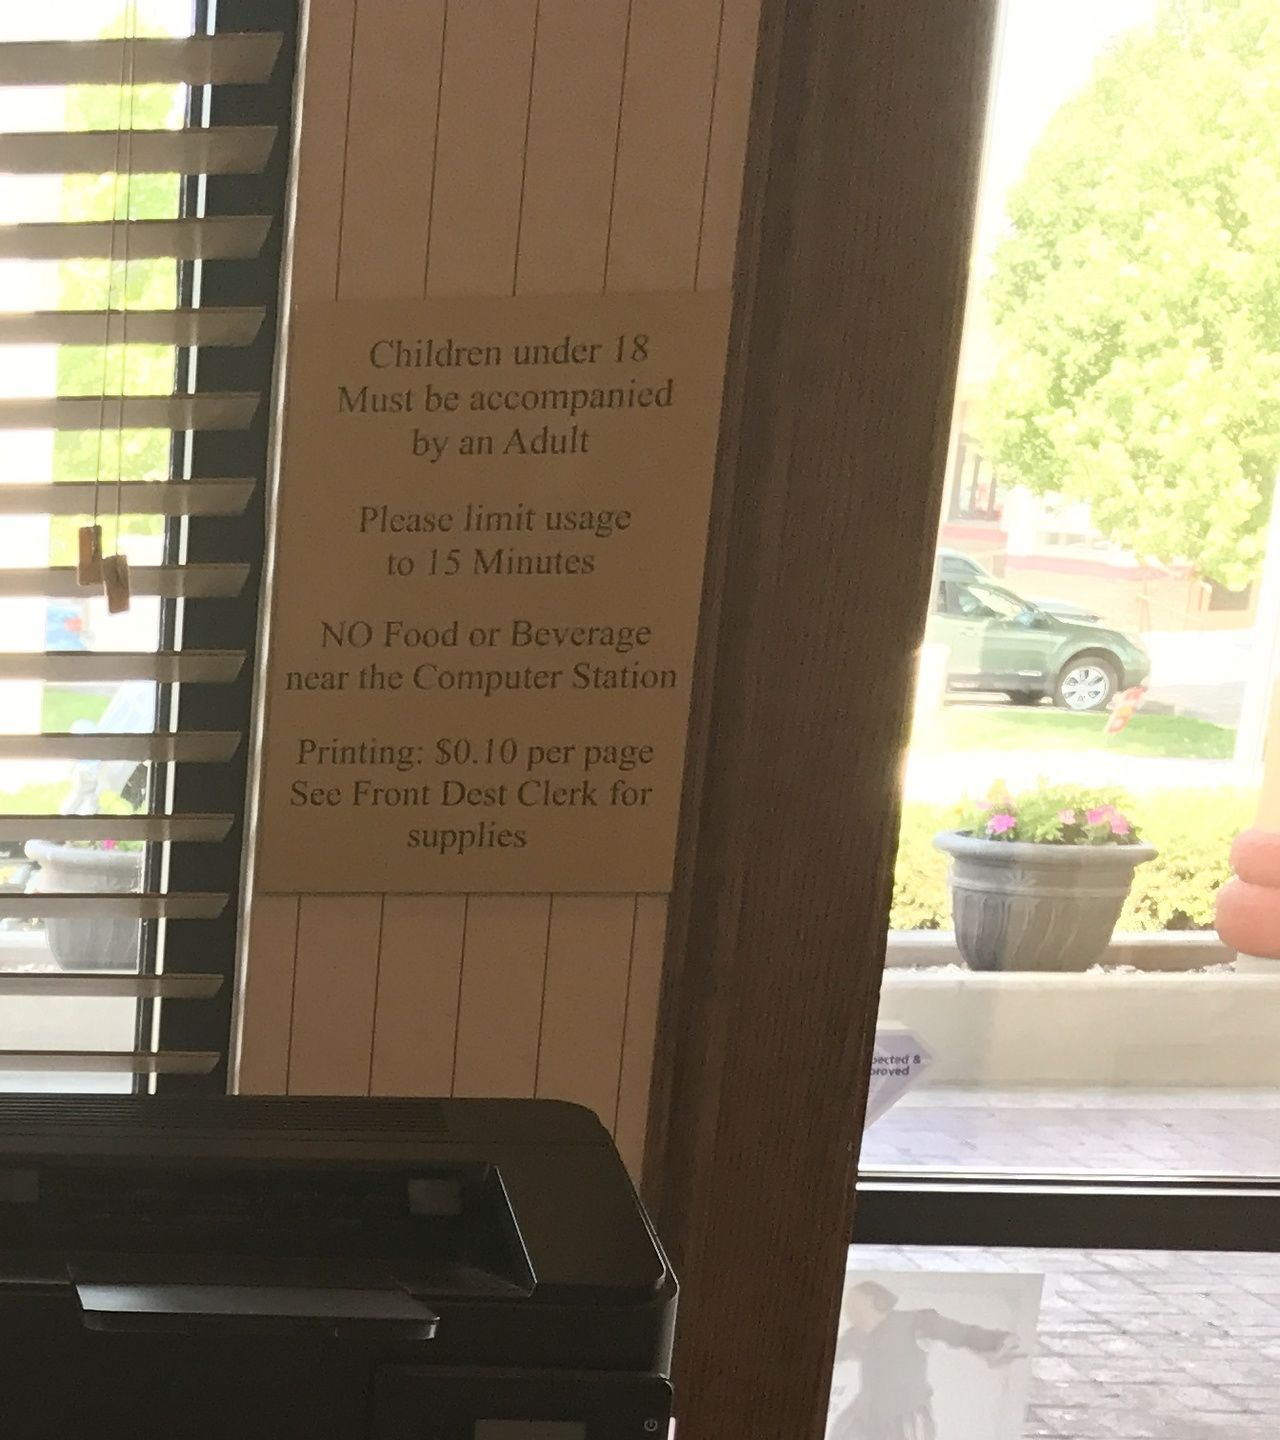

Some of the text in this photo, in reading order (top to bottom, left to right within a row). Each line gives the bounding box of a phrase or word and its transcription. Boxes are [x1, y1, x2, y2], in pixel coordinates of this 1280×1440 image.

[370, 334, 649, 368] Children under 18
[338, 379, 674, 416] Must be accompanied
[412, 425, 591, 464] by an Adult
[359, 502, 632, 537] Please limit usage
[387, 547, 596, 577] to 15 Minutes
[321, 619, 652, 653] NO Food or Beverage
[285, 661, 678, 696] near the Computer Station
[296, 737, 654, 772] Printing: $0.10 per page
[290, 779, 653, 807] See Front Dest Clerk for
[406, 821, 528, 855] supplies
